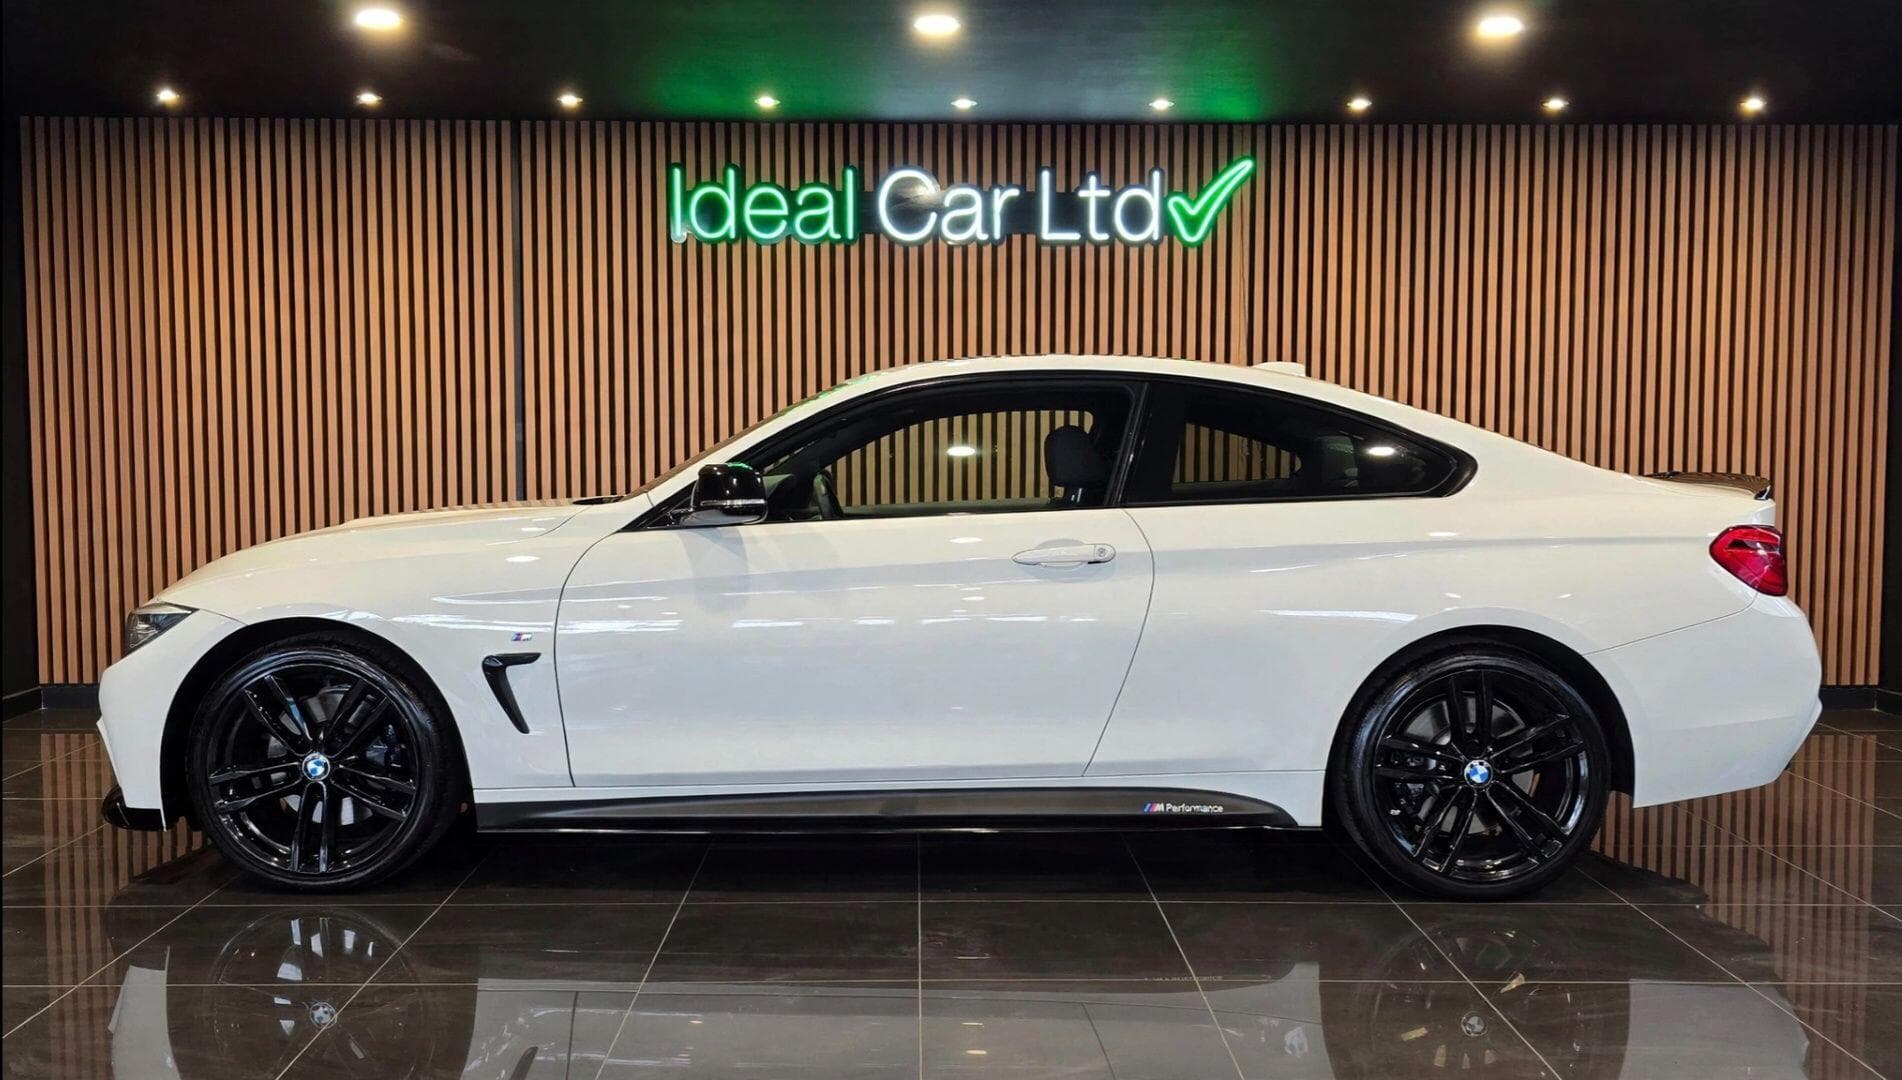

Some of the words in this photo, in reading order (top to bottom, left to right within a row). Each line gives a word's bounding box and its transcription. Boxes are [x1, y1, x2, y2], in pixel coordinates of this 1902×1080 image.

[672, 167, 855, 241] Ideal
[878, 169, 1020, 241] Car
[1041, 170, 1160, 241] Ltd
[1166, 803, 1224, 813] Performance
